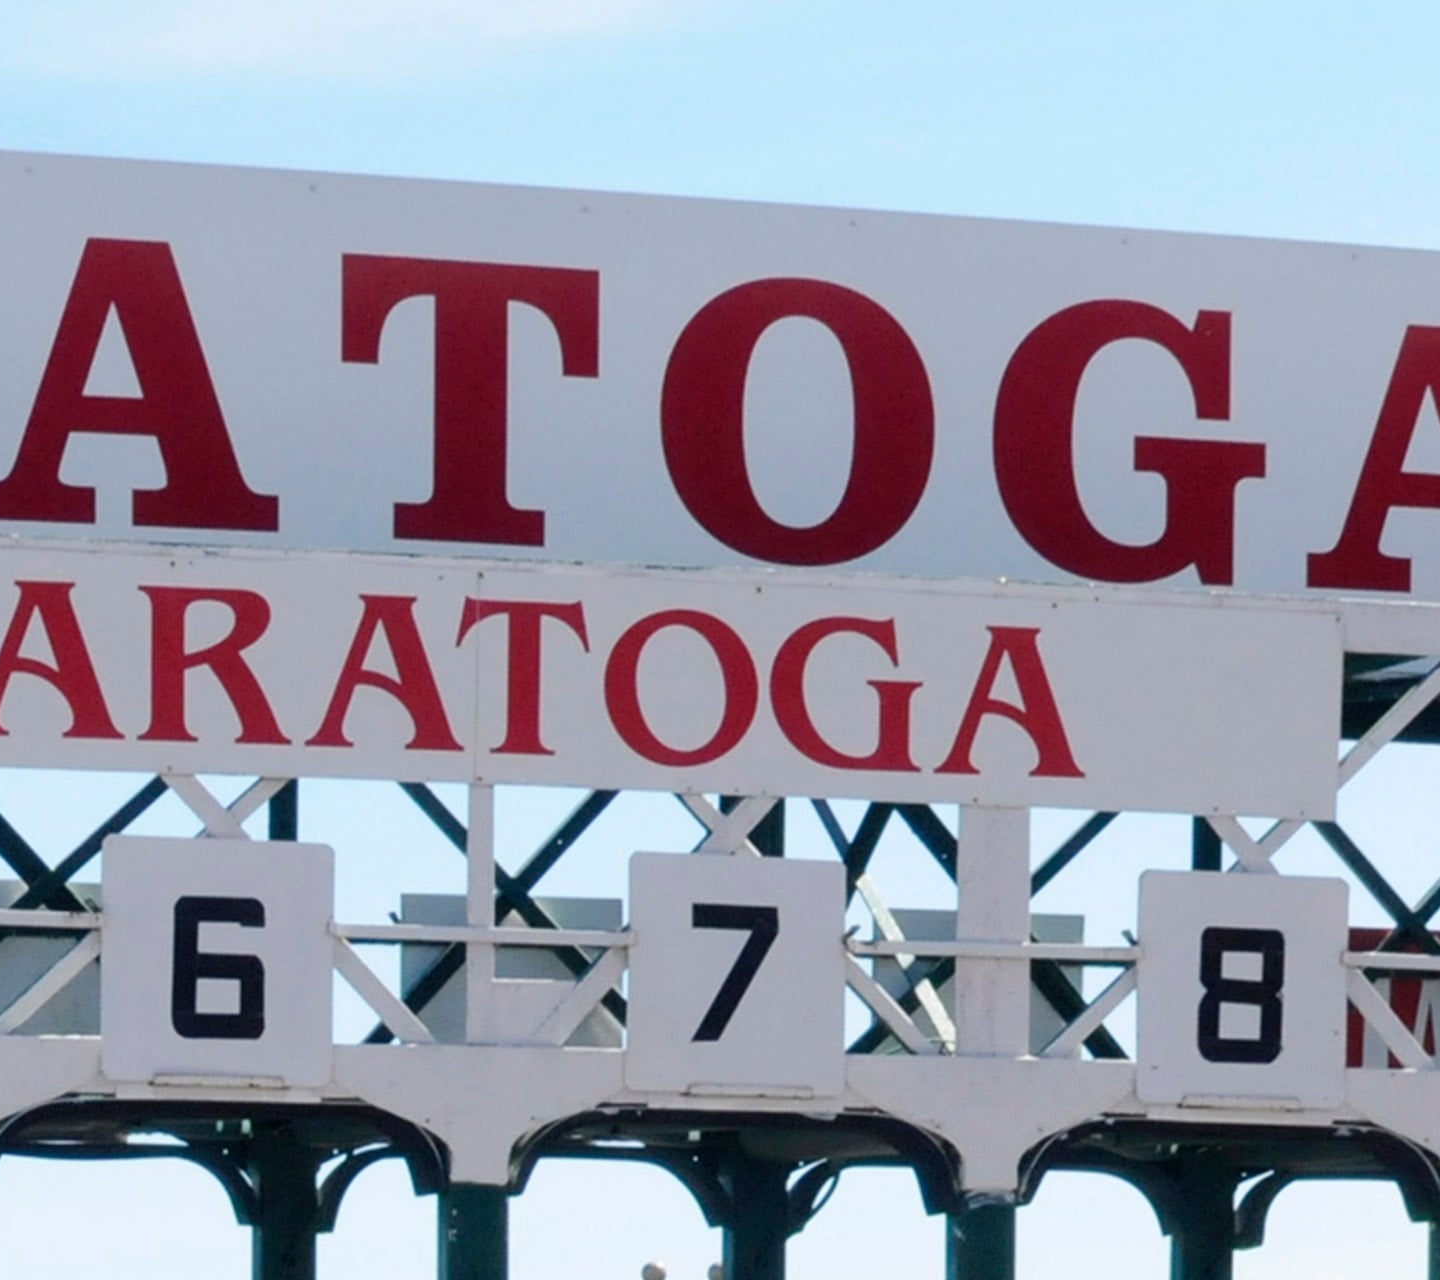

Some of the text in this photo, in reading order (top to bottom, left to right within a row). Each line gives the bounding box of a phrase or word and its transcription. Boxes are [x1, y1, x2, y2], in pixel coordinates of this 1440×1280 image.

[171, 896, 265, 1040] 6
[692, 903, 779, 1042] 7
[1197, 926, 1285, 1064] 8
